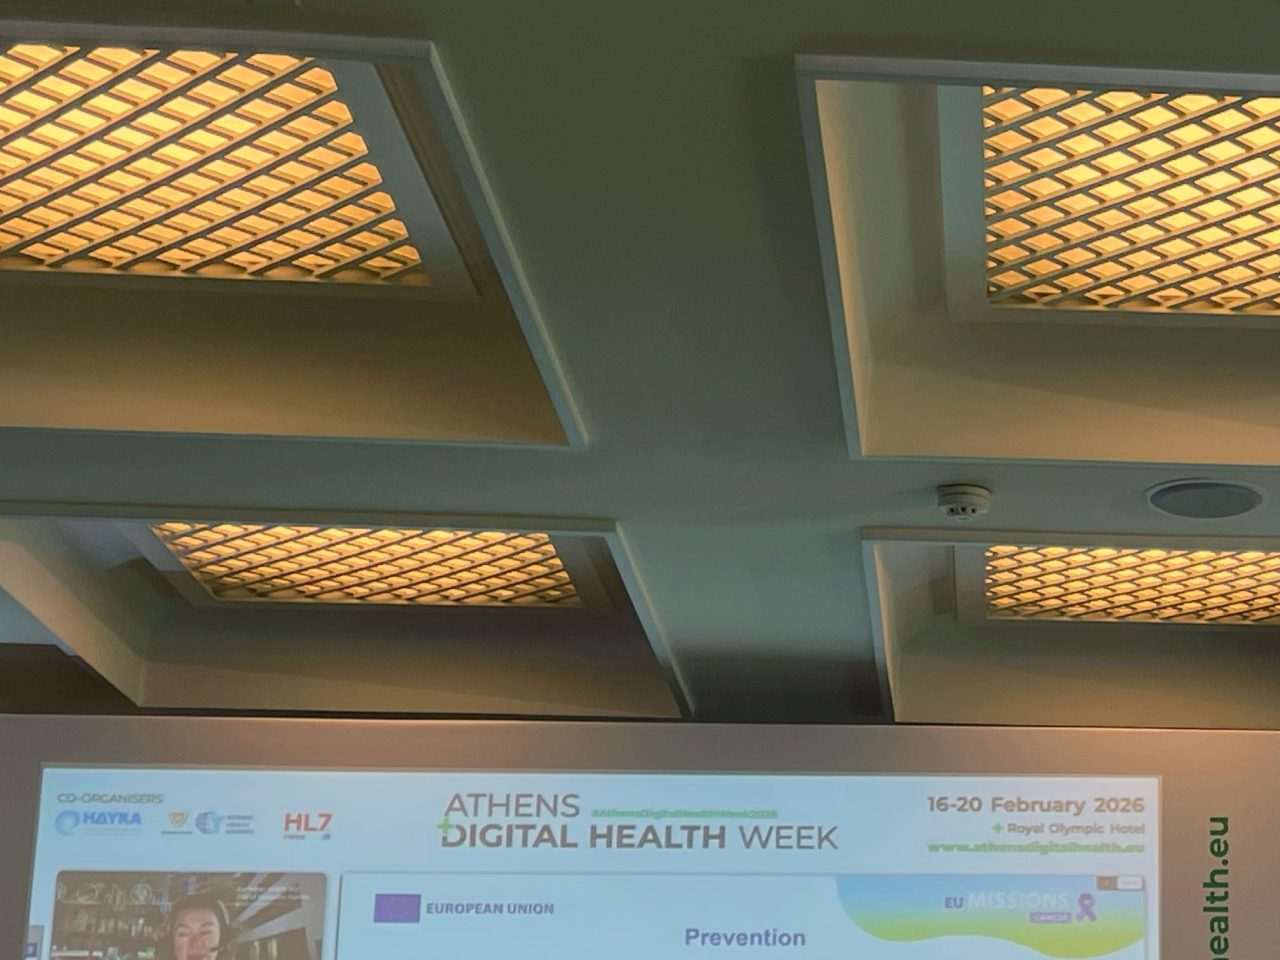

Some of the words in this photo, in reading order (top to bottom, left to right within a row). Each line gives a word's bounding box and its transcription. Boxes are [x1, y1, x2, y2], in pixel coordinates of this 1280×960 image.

[444, 793, 581, 818] ATHENS
[928, 797, 982, 813] 16-20
[991, 797, 1086, 816] February
[1094, 797, 1145, 814] 2026
[284, 813, 333, 832] HL7
[1007, 823, 1045, 836] Royal
[1049, 823, 1105, 836] Olympic
[1110, 823, 1146, 835] Hotel
[441, 823, 578, 848] DIGITAL
[590, 824, 726, 849] HEALTH
[739, 825, 839, 851] WEEK
[426, 903, 504, 915] EUROPEAN
[507, 903, 555, 915] UNION
[944, 897, 965, 909] EU
[967, 891, 1070, 909] MISSIONS
[685, 928, 806, 947] Prevention
